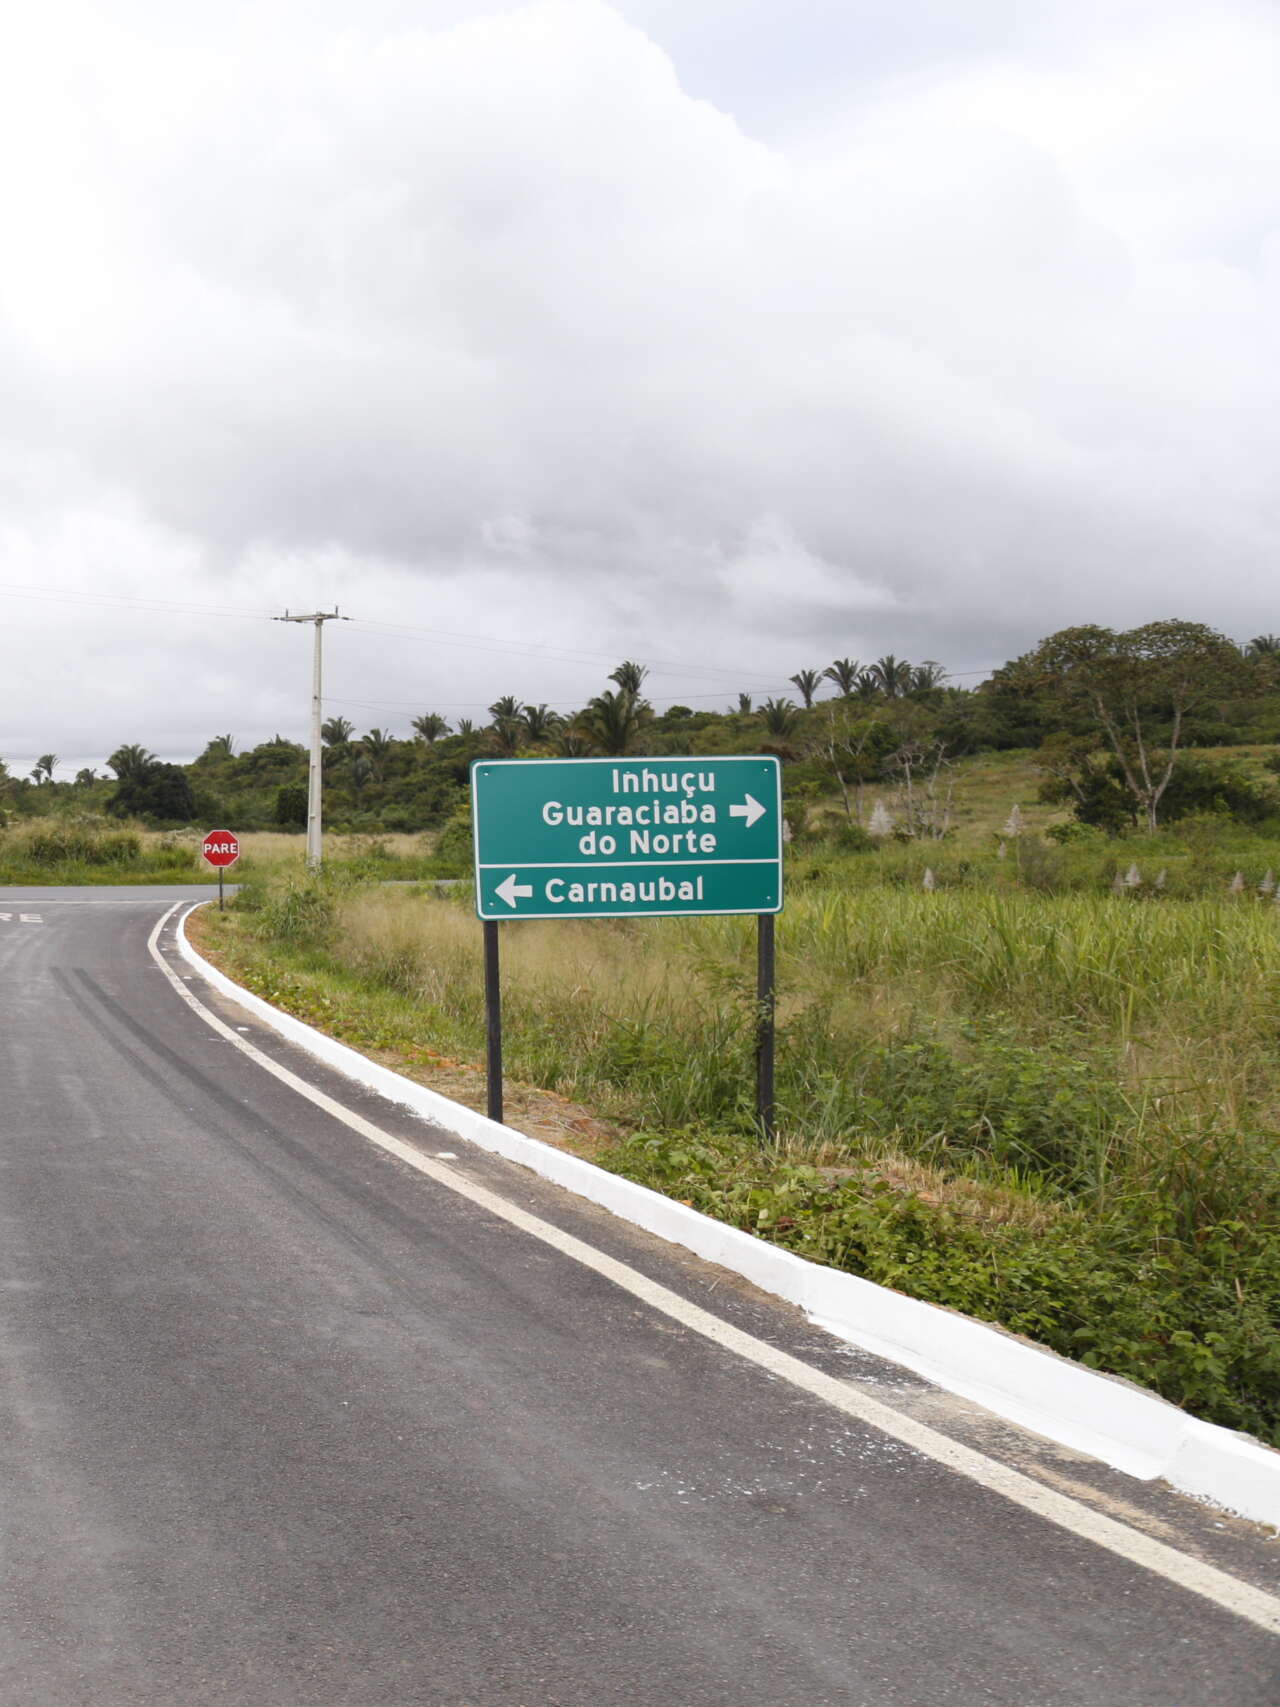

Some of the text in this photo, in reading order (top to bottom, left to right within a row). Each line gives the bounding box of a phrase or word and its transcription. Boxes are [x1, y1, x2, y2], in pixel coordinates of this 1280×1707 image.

[612, 768, 716, 798] Inhuçu
[542, 800, 717, 826] Guaraciaba
[204, 843, 238, 854] PARE
[578, 830, 717, 855] do Norte
[545, 876, 704, 903] Carnaubal
